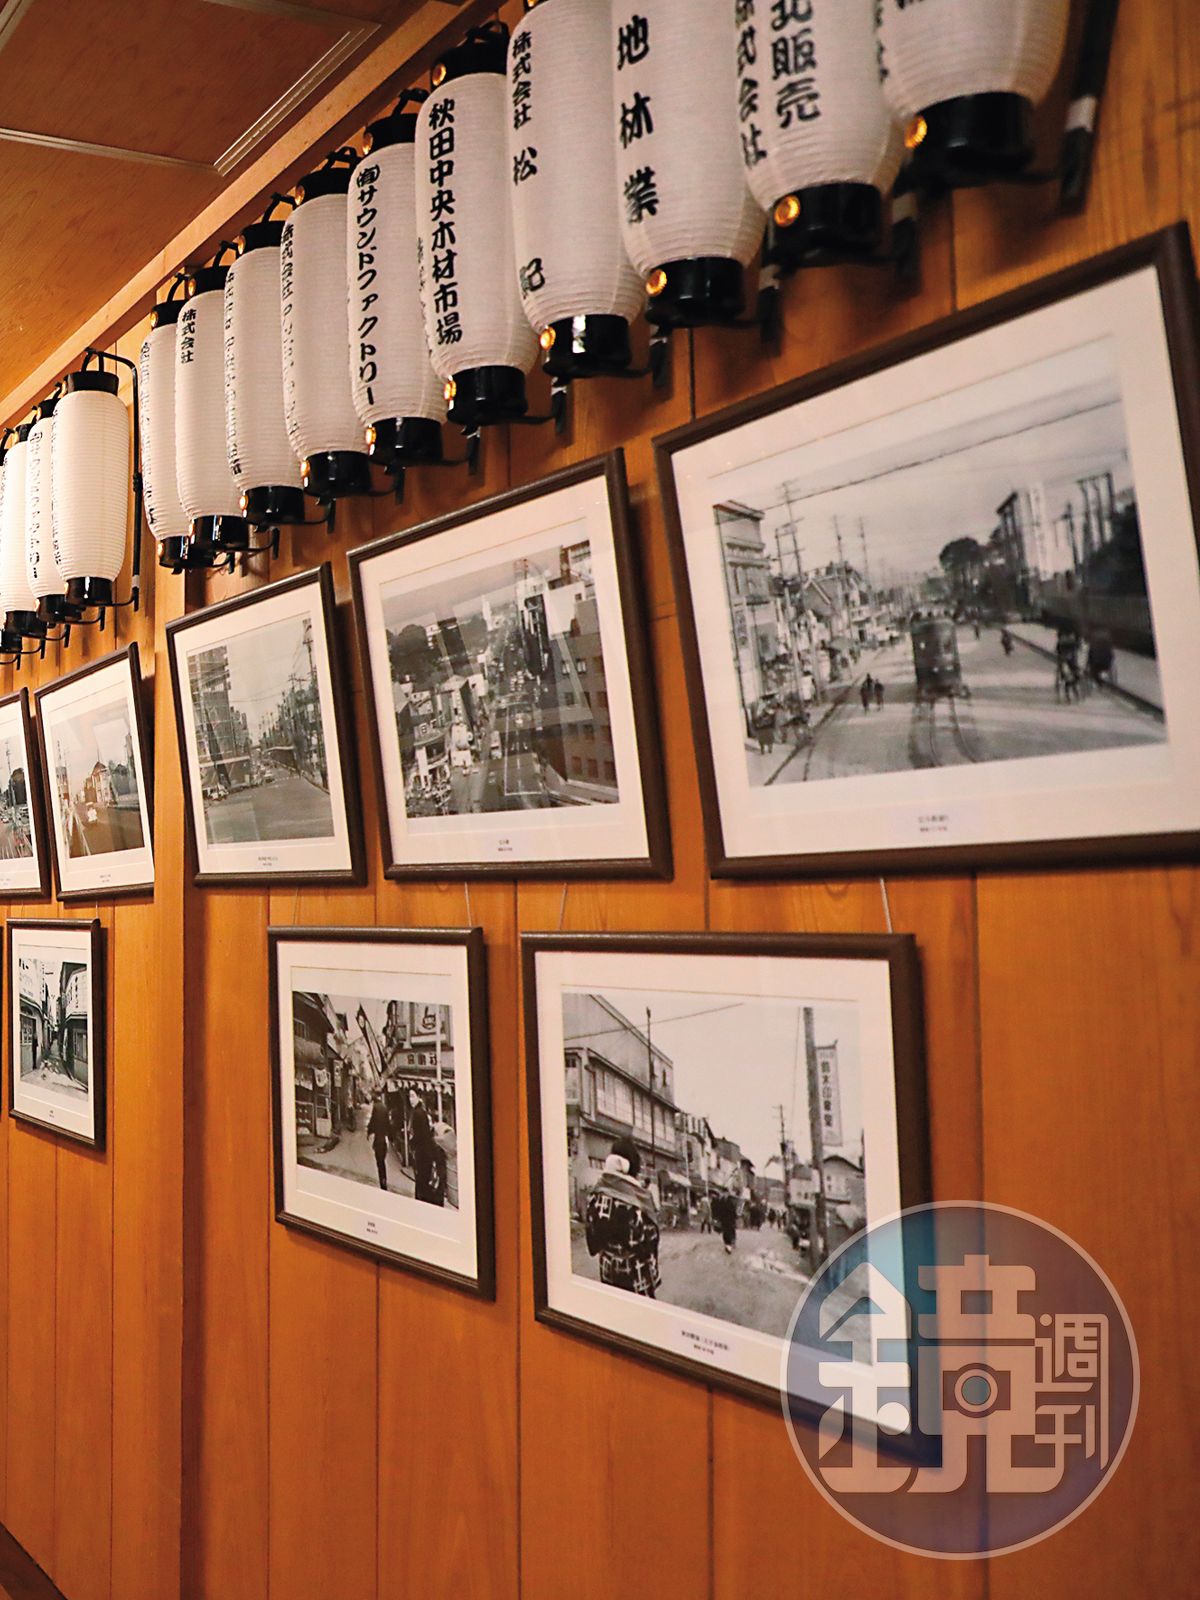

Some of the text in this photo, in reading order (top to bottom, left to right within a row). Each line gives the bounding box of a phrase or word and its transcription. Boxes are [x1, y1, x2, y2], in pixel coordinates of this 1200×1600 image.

[511, 29, 533, 130] 株式会社
[428, 97, 463, 346] 秋田中央木材市場
